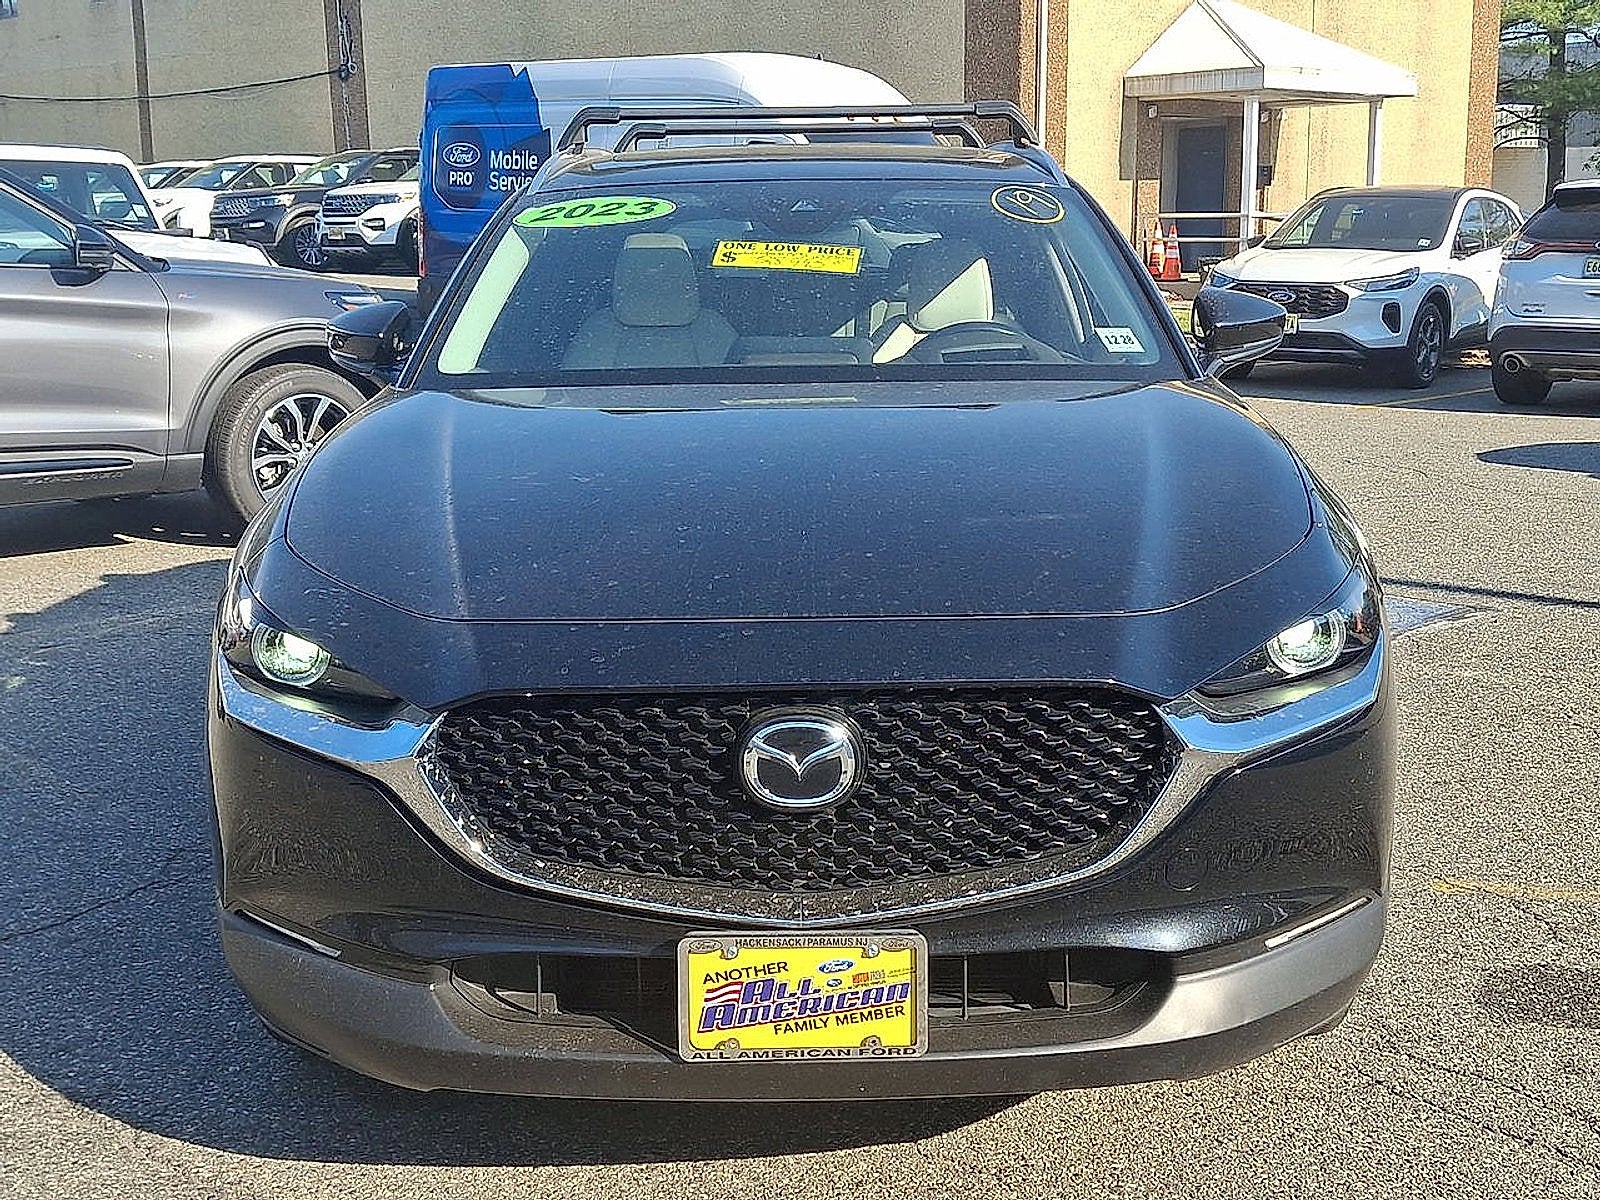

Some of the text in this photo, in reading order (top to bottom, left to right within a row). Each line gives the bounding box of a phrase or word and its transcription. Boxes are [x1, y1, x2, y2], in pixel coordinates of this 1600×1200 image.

[489, 149, 538, 170] Mobile
[449, 171, 473, 186] PRO
[528, 201, 660, 223] 2023
[723, 242, 856, 256] ONE LOW PRICE
[720, 251, 737, 263] $
[855, 938, 868, 947] NJ
[702, 961, 789, 985] ANOTHER
[773, 1006, 906, 1035] FAMILY MEMBER
[691, 1047, 917, 1060] ALL AMERICAN FORD
